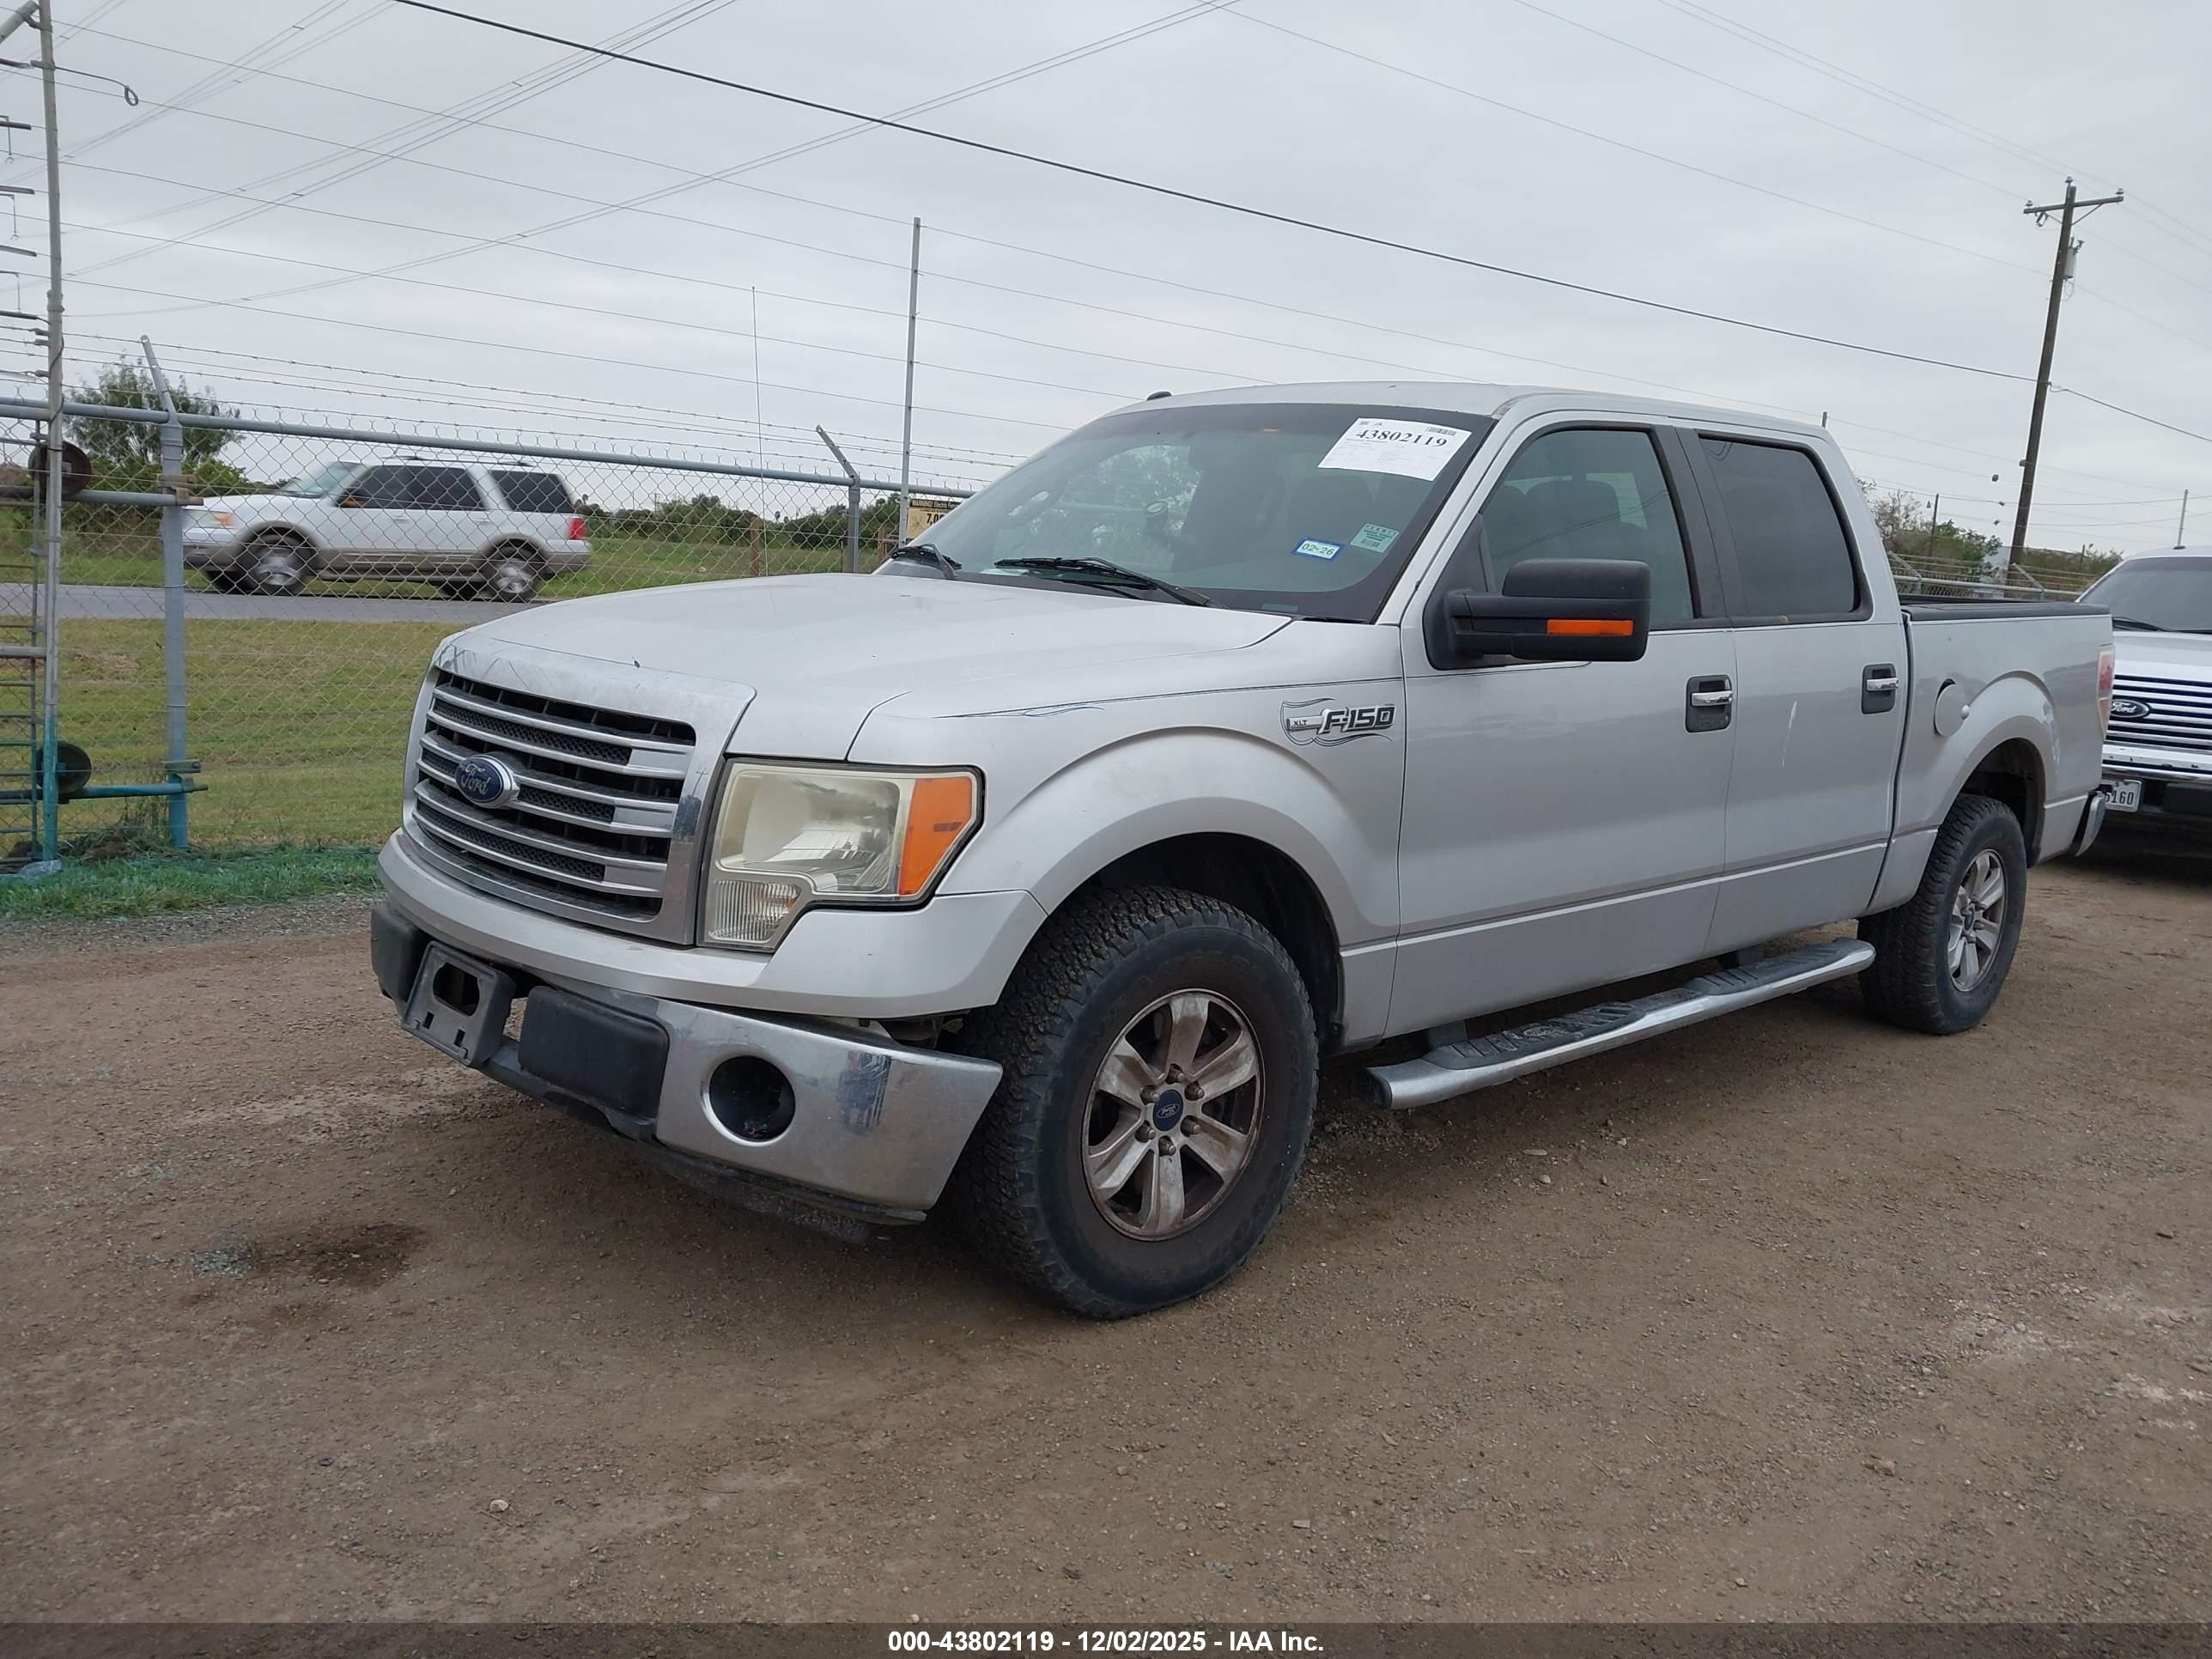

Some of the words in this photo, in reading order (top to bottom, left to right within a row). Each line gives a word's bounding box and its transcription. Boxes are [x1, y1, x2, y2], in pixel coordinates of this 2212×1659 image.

[1356, 428, 1448, 447] 43802119
[1301, 543, 1335, 556] 02-26
[2111, 701, 2137, 714] Ford
[1317, 705, 1395, 734] F-150
[460, 763, 492, 796] Ford
